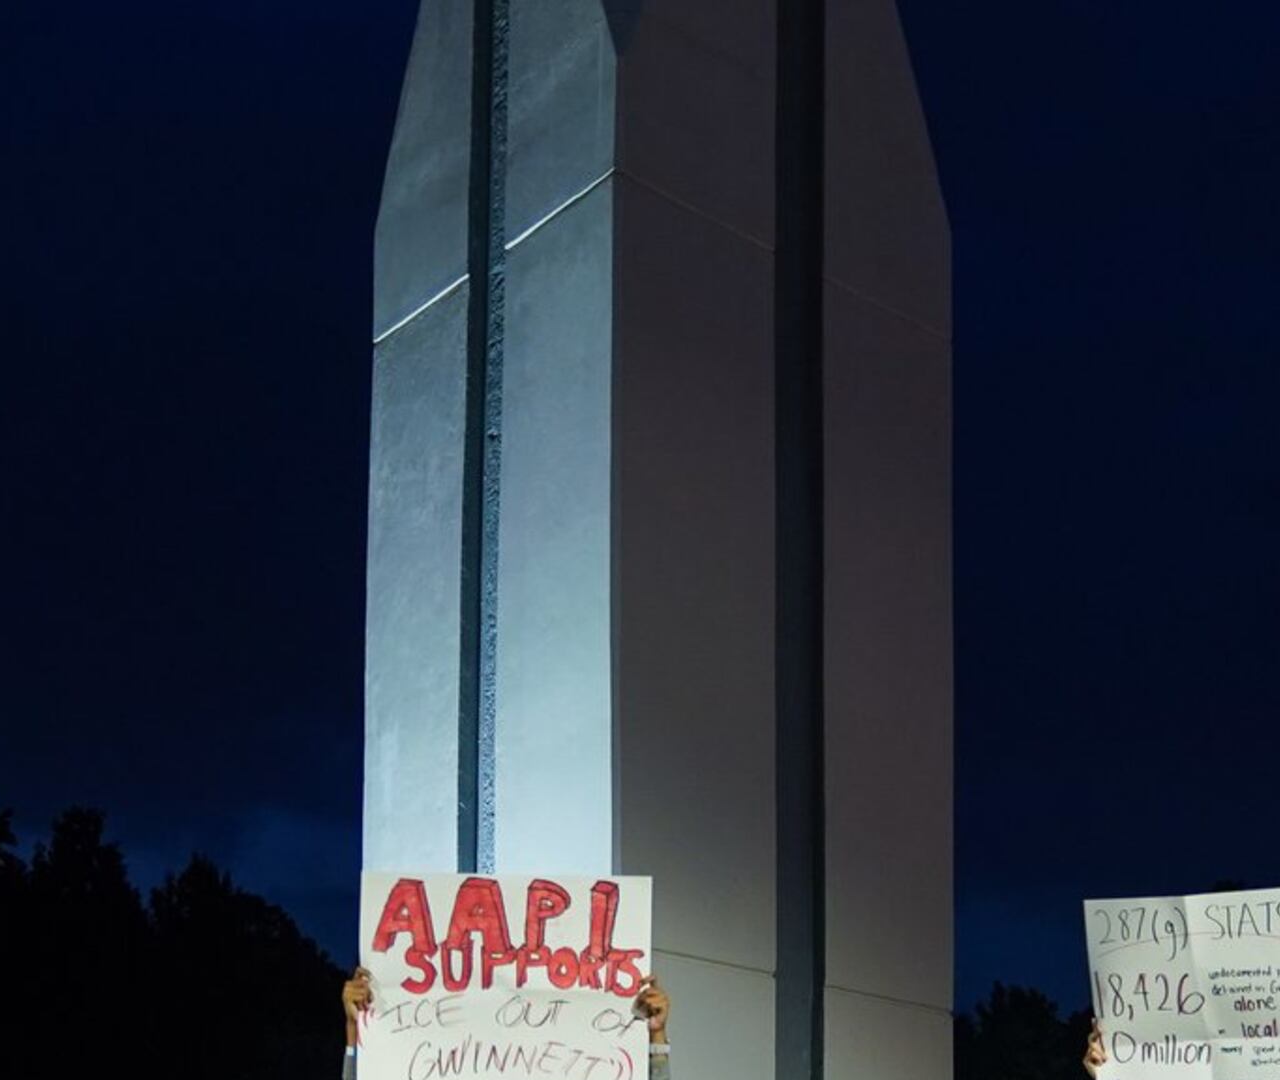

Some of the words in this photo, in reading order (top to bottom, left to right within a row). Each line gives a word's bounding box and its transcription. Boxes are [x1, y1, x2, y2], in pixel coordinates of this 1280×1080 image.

[372, 877, 619, 953] AAPI
[1094, 905, 1188, 961] 287(g)
[401, 939, 644, 997] SUPPORTS
[495, 995, 571, 1028] OUT
[1094, 971, 1206, 1020] 18,426
[1234, 995, 1277, 1012] alone
[1241, 1018, 1278, 1038] local
[1141, 1034, 1211, 1065] million
